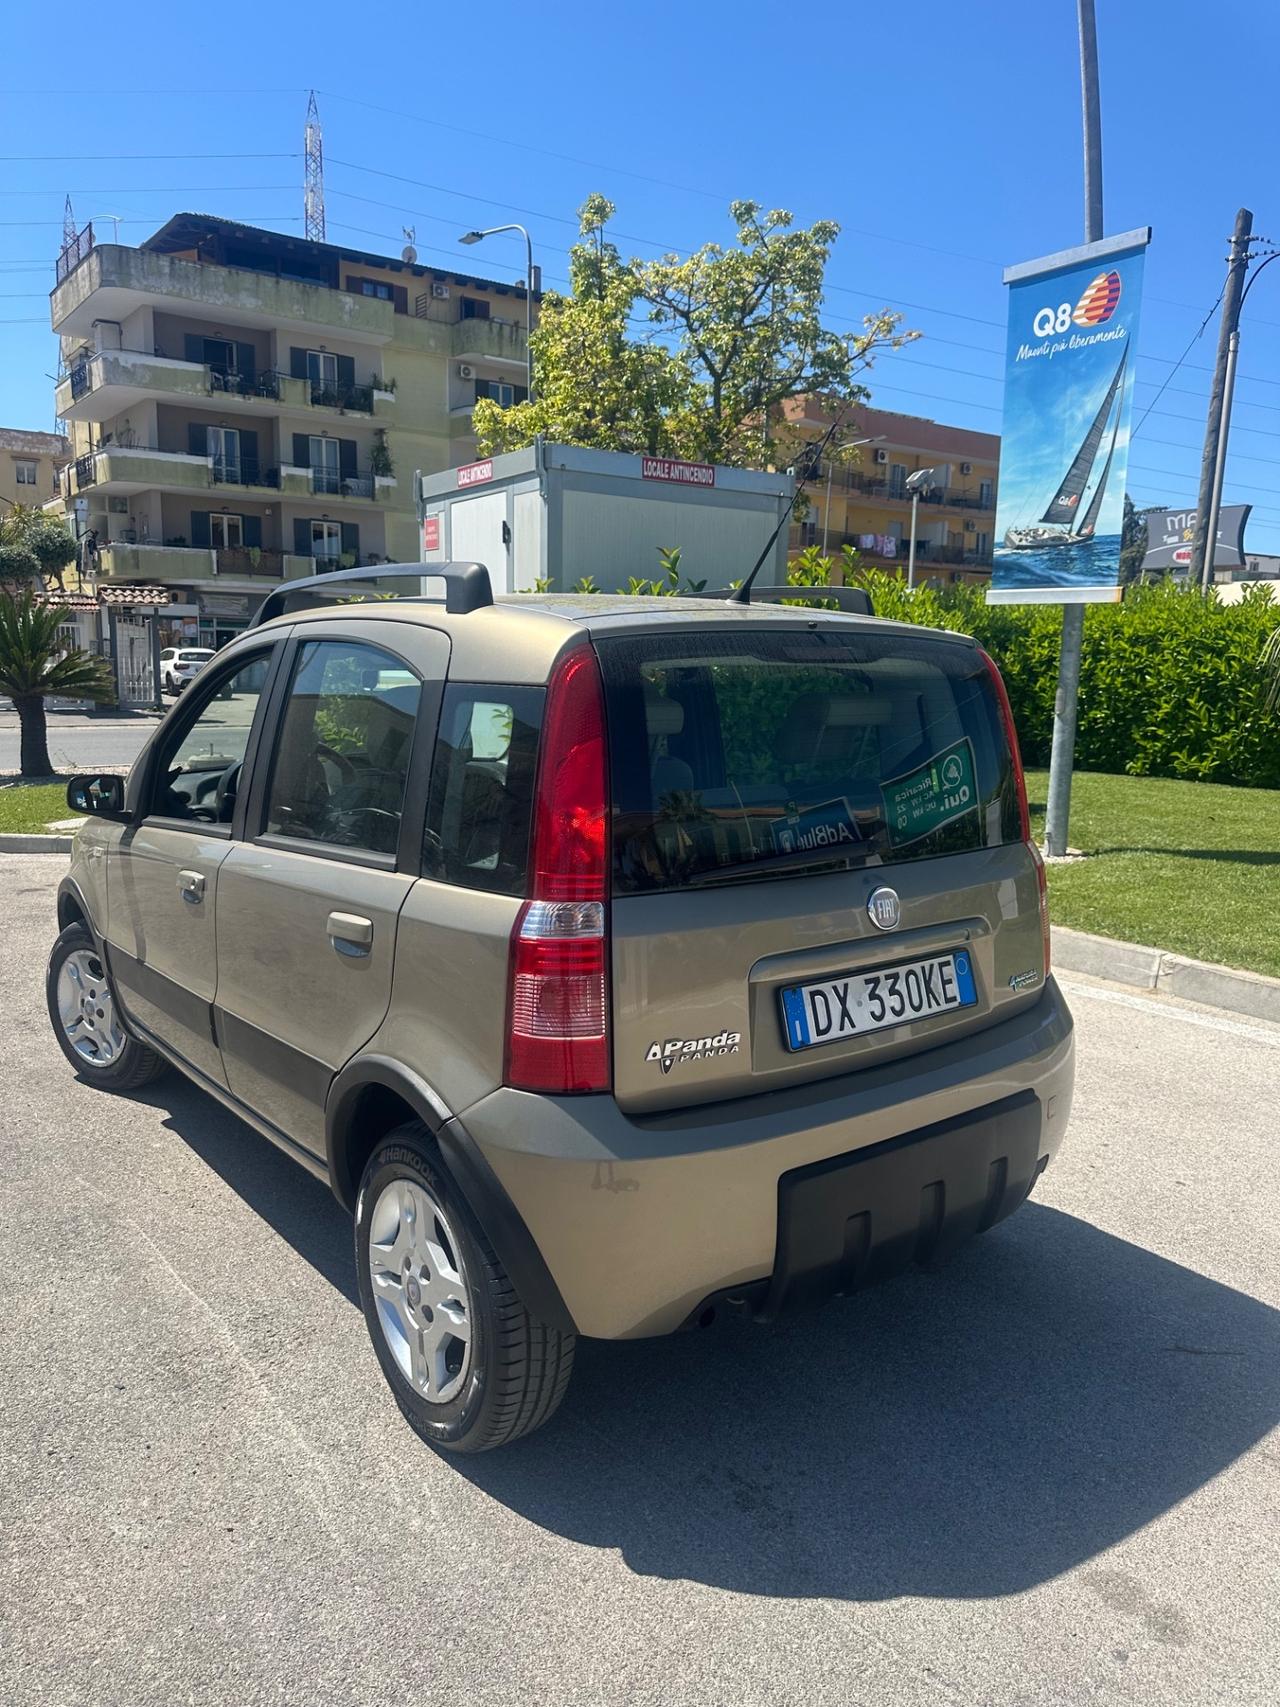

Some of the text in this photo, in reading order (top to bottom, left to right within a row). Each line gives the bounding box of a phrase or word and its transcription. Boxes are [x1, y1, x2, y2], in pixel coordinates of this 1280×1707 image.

[1033, 302, 1072, 337] Q8
[1069, 324, 1127, 349] liberamente
[644, 459, 714, 484] LOCALE ANTINCENDIO
[877, 898, 895, 919] FIAT
[809, 982, 857, 1037] DX
[864, 960, 958, 1023] 330KE
[663, 1030, 741, 1056] Panda
[679, 1045, 739, 1063] PANDA
